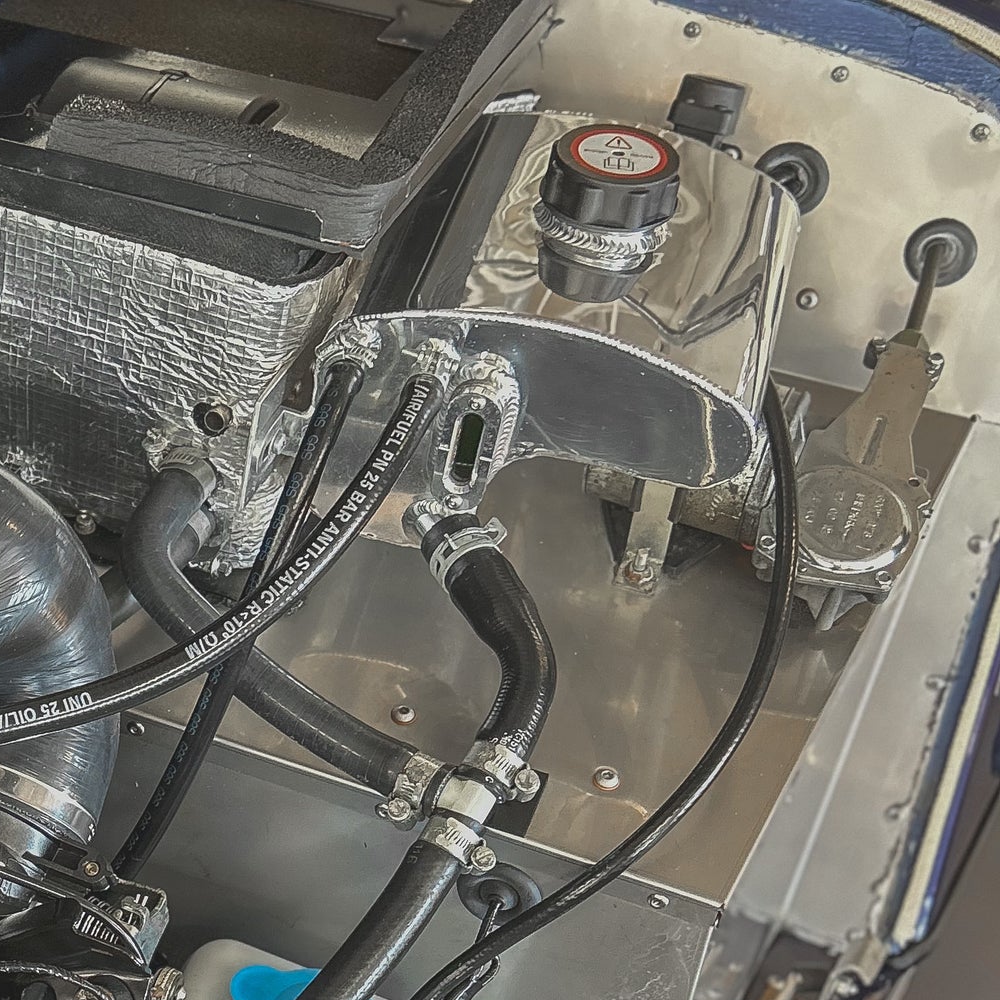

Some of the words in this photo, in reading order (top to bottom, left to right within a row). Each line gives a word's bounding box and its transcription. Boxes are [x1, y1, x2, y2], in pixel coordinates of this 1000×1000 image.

[371, 448, 394, 472] PN
[284, 470, 304, 498] GAS
[358, 470, 378, 490] 25
[333, 489, 366, 522] BAR
[257, 520, 343, 606] ANTI-STATIC
[39, 700, 59, 718] 25
[62, 690, 92, 711] UNI
